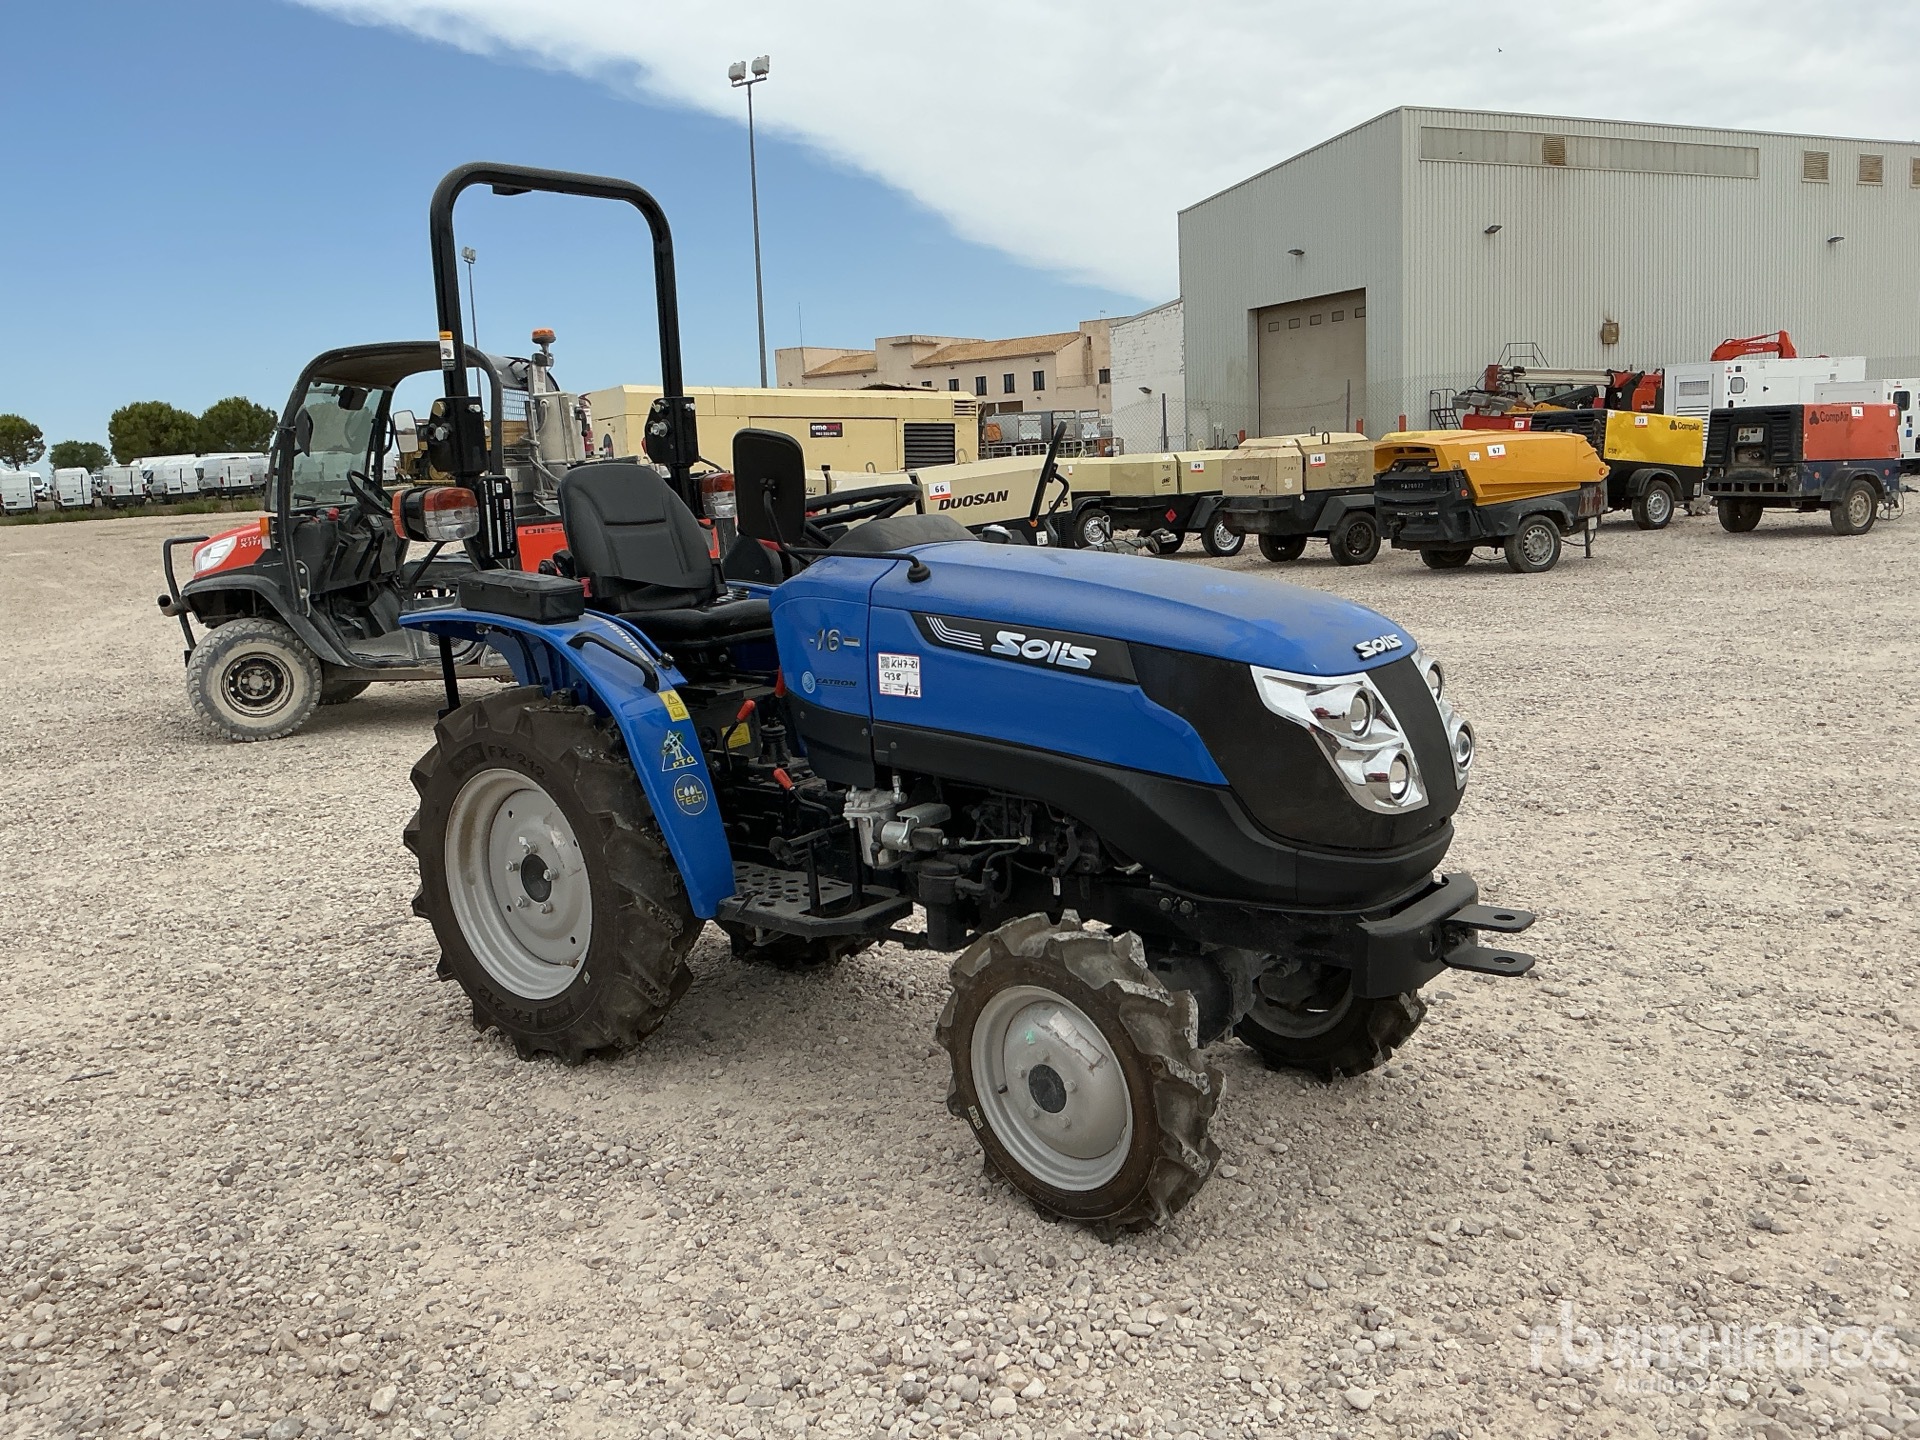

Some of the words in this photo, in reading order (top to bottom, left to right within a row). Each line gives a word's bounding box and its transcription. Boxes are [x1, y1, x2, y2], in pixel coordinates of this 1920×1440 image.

[1820, 410, 1849, 424] CompAir
[1677, 421, 1700, 431] CompAir
[934, 485, 945, 493] 66
[938, 489, 1009, 511] DOOSAN
[884, 672, 901, 681] 938
[672, 756, 695, 769] PTO
[676, 784, 703, 798] COOL
[679, 794, 705, 806] TECH
